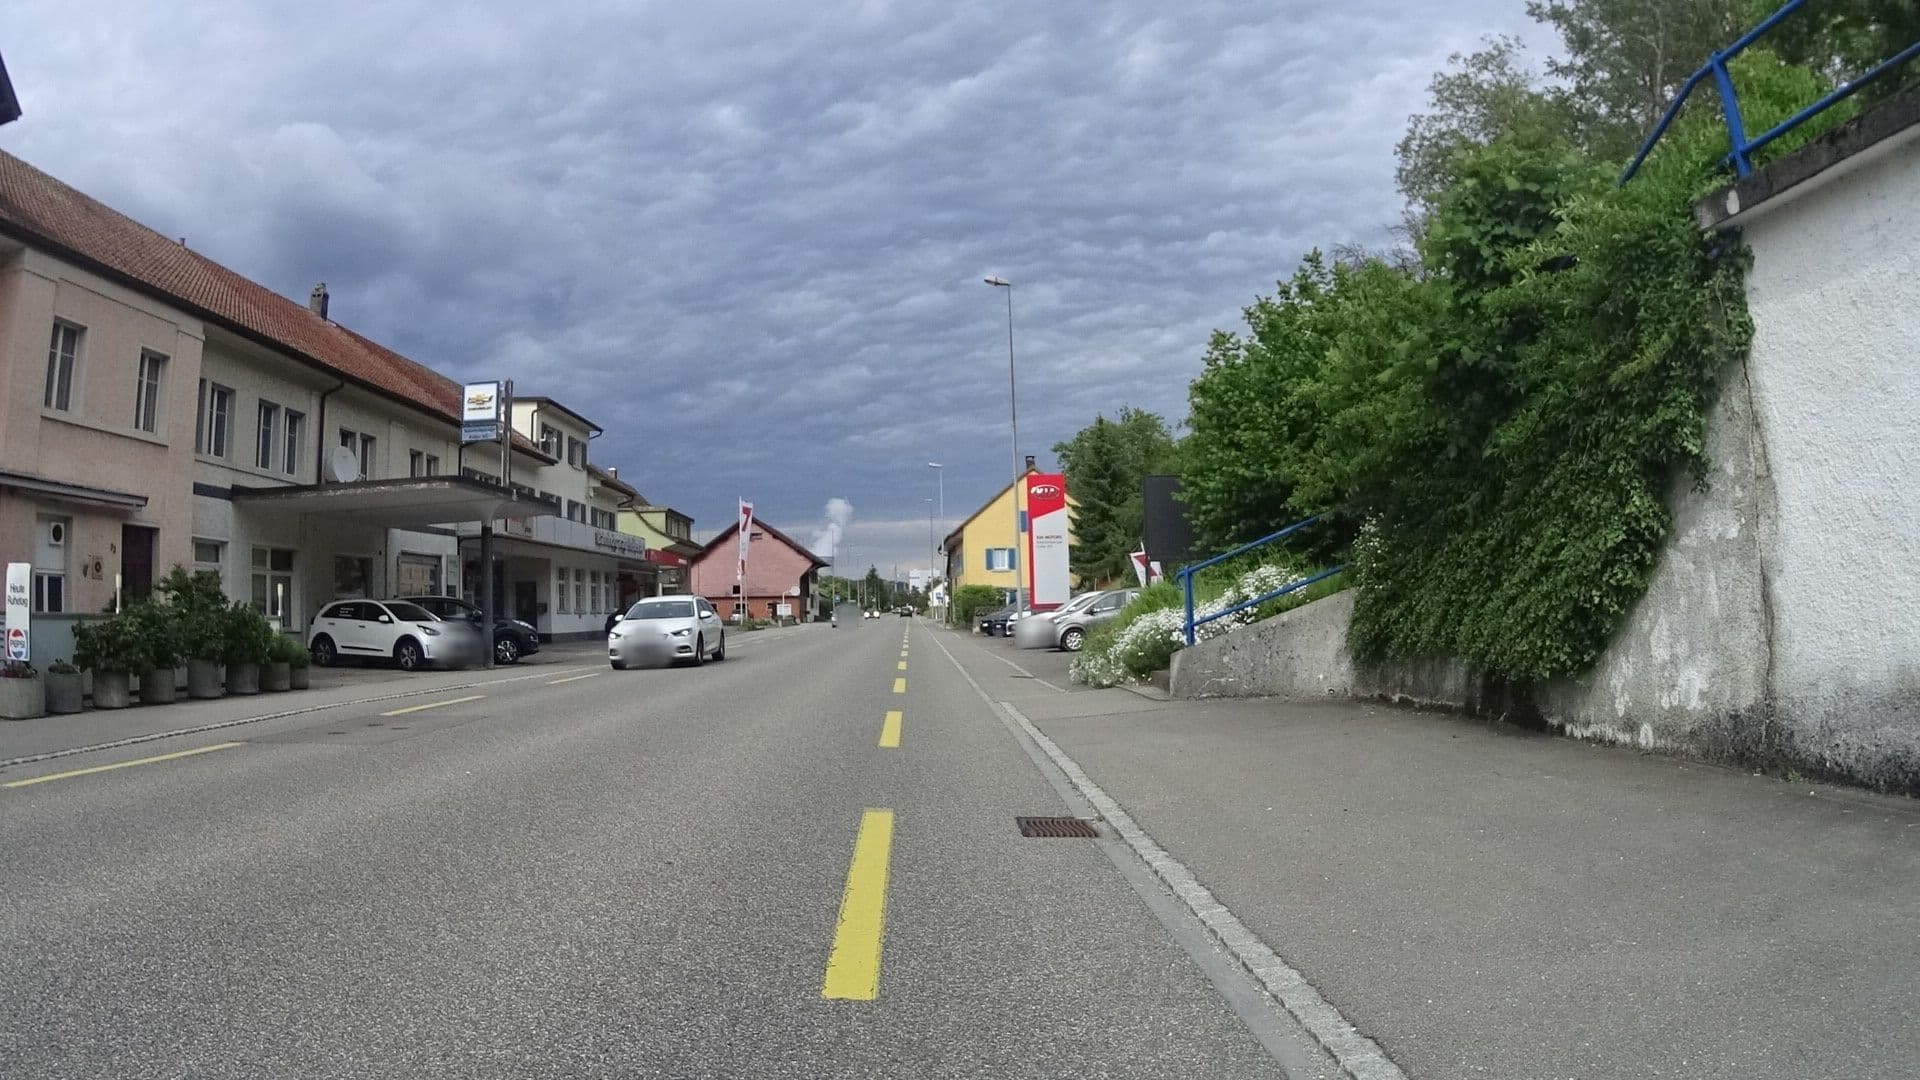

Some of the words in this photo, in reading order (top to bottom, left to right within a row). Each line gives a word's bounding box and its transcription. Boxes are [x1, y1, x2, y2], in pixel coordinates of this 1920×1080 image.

[10, 583, 25, 593] Heute
[7, 596, 28, 608] Ruhetag
[10, 639, 25, 648] PEPSI
